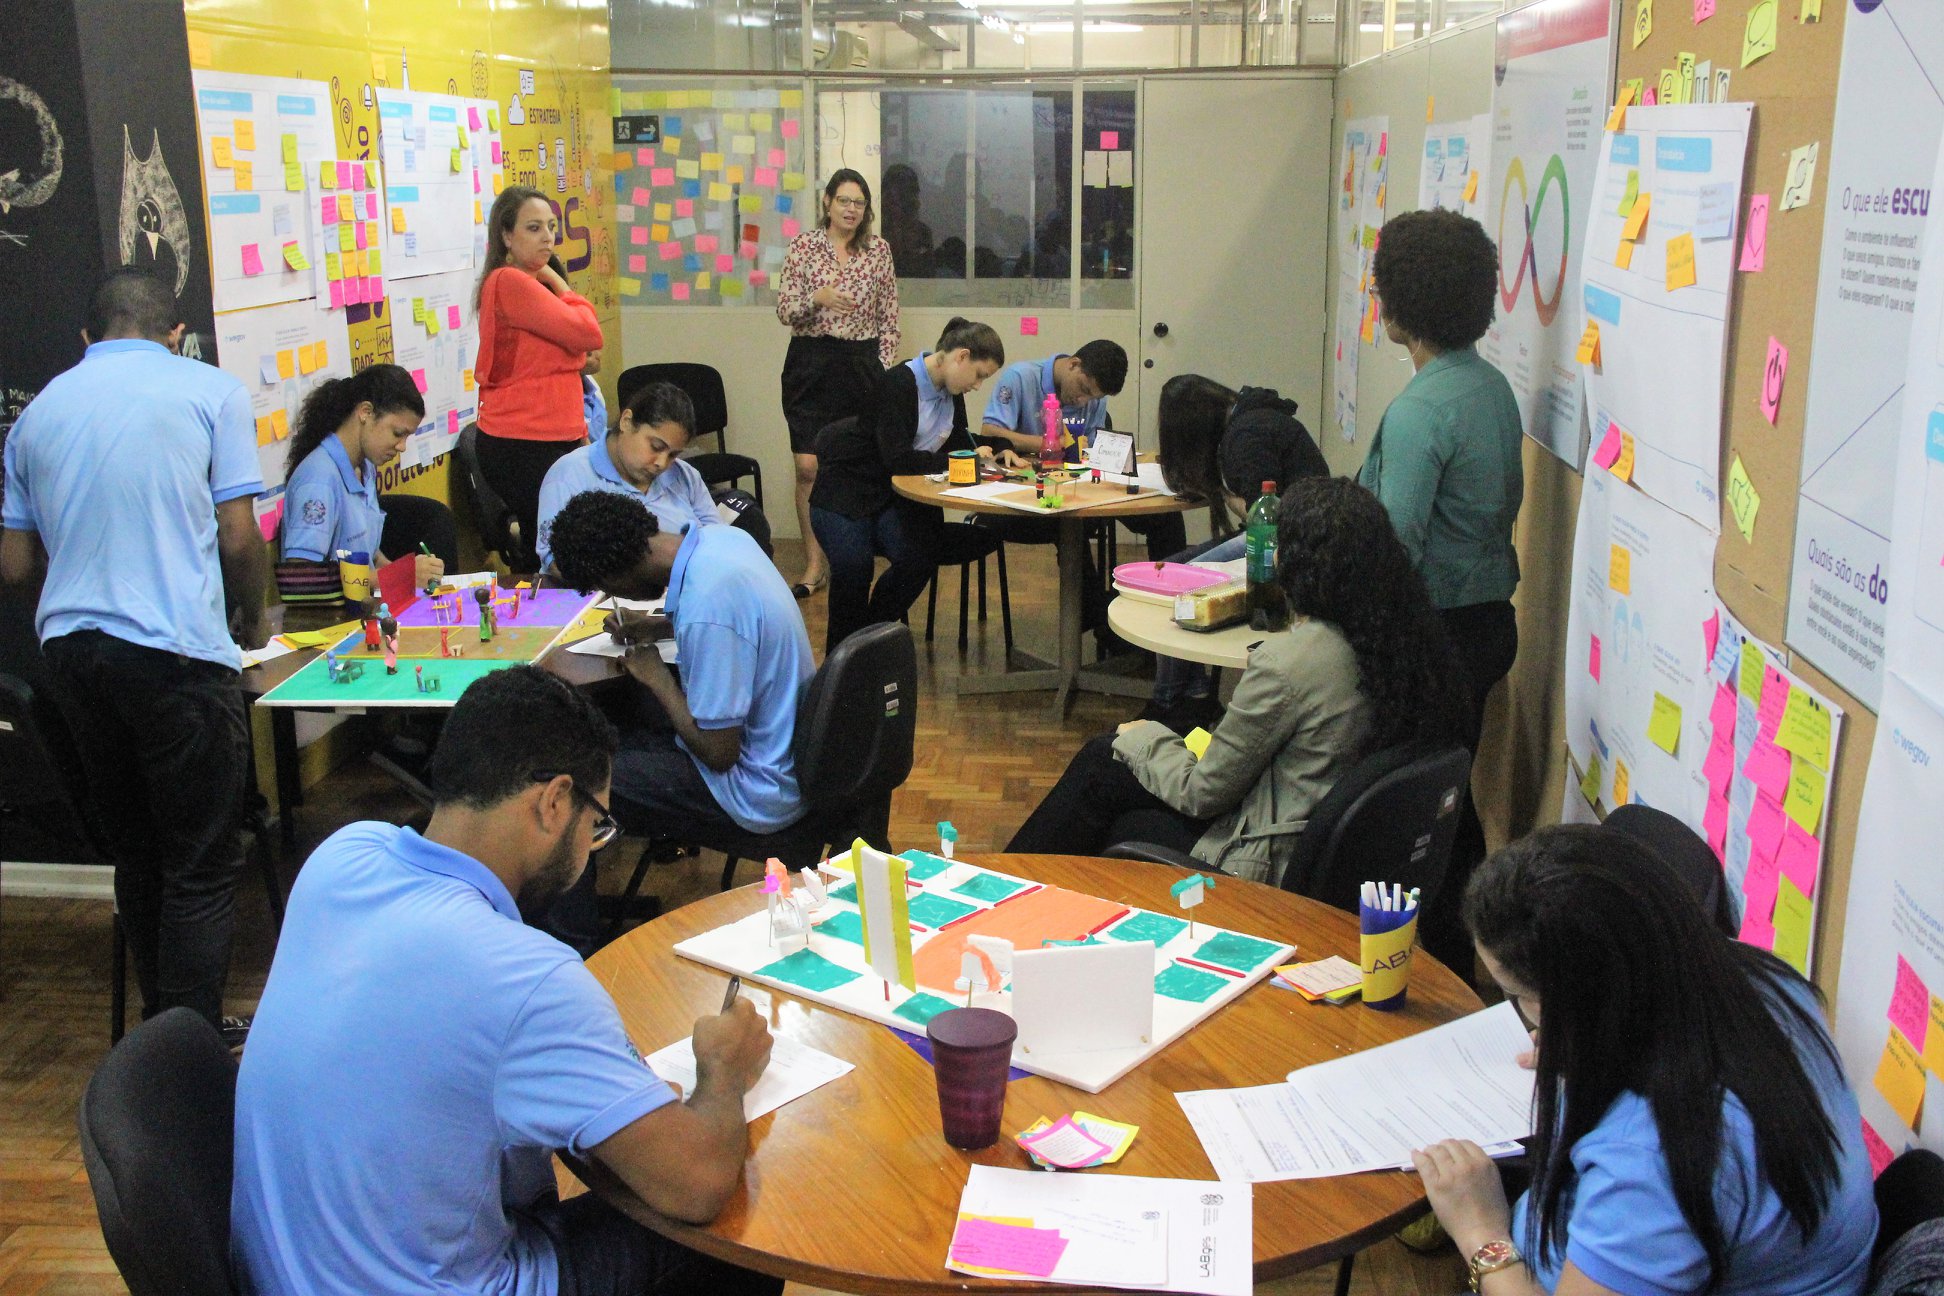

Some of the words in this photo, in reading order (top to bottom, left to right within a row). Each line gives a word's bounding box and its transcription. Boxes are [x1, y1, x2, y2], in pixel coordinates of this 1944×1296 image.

[529, 104, 562, 124] ESTRATÉGIA
[1842, 186, 1851, 210] O
[1852, 191, 1871, 218] que
[1872, 188, 1889, 214] ele
[1808, 538, 1833, 572] Quais
[1834, 558, 1852, 584] são
[1854, 572, 1867, 592] as
[1900, 734, 1930, 768] wegov
